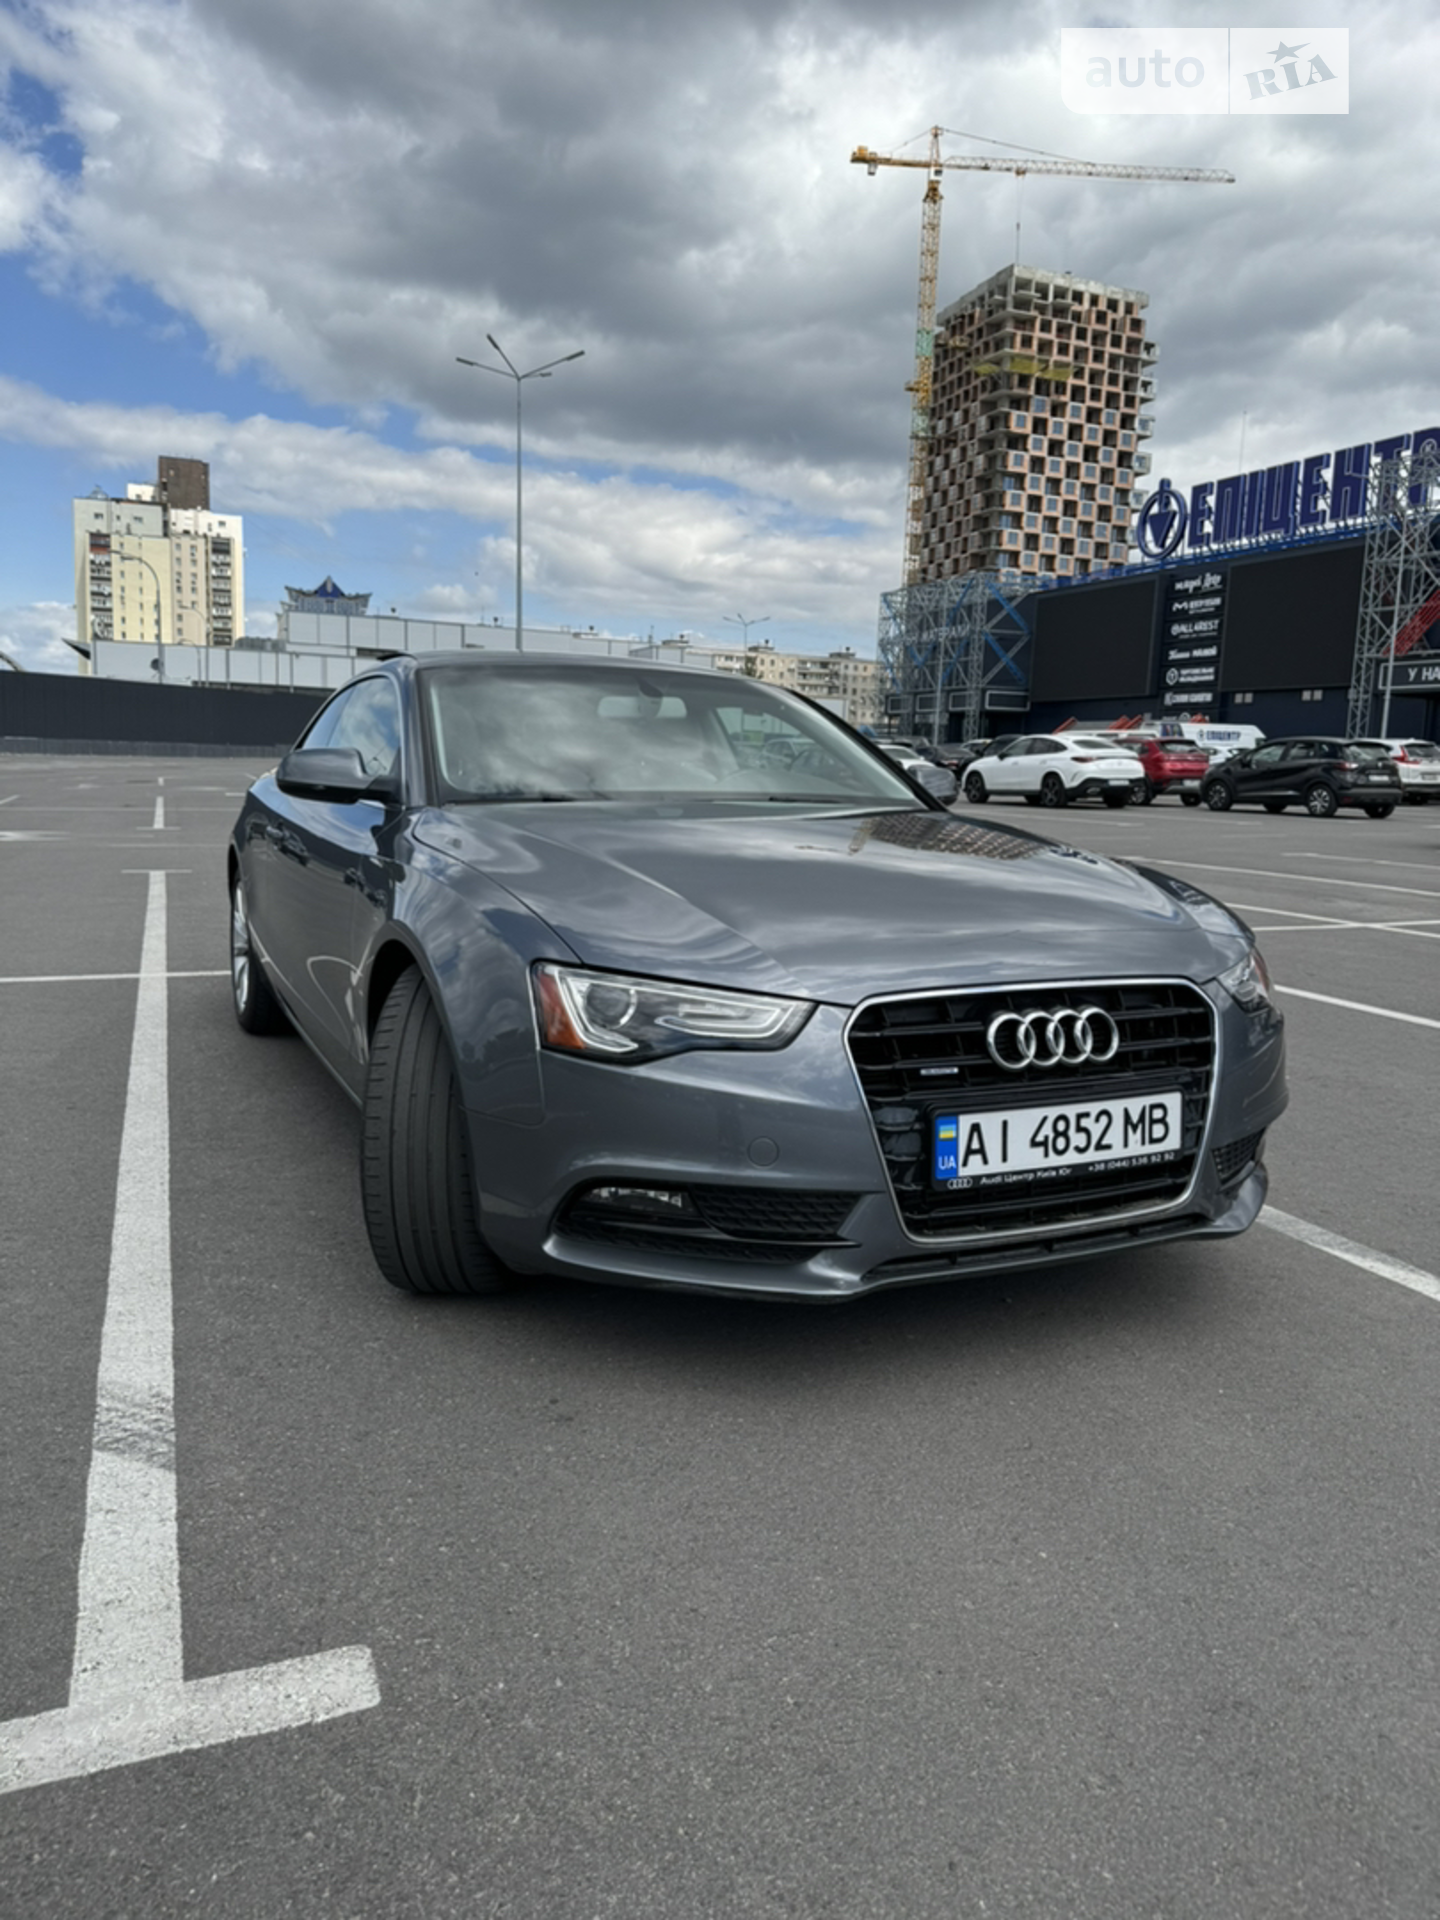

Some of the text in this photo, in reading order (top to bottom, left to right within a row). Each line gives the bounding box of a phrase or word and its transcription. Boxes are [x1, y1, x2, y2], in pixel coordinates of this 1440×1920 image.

[961, 1102, 1170, 1167] AI 4852 MB
[938, 1156, 957, 1170] UA
[980, 1174, 1002, 1185] Audi
